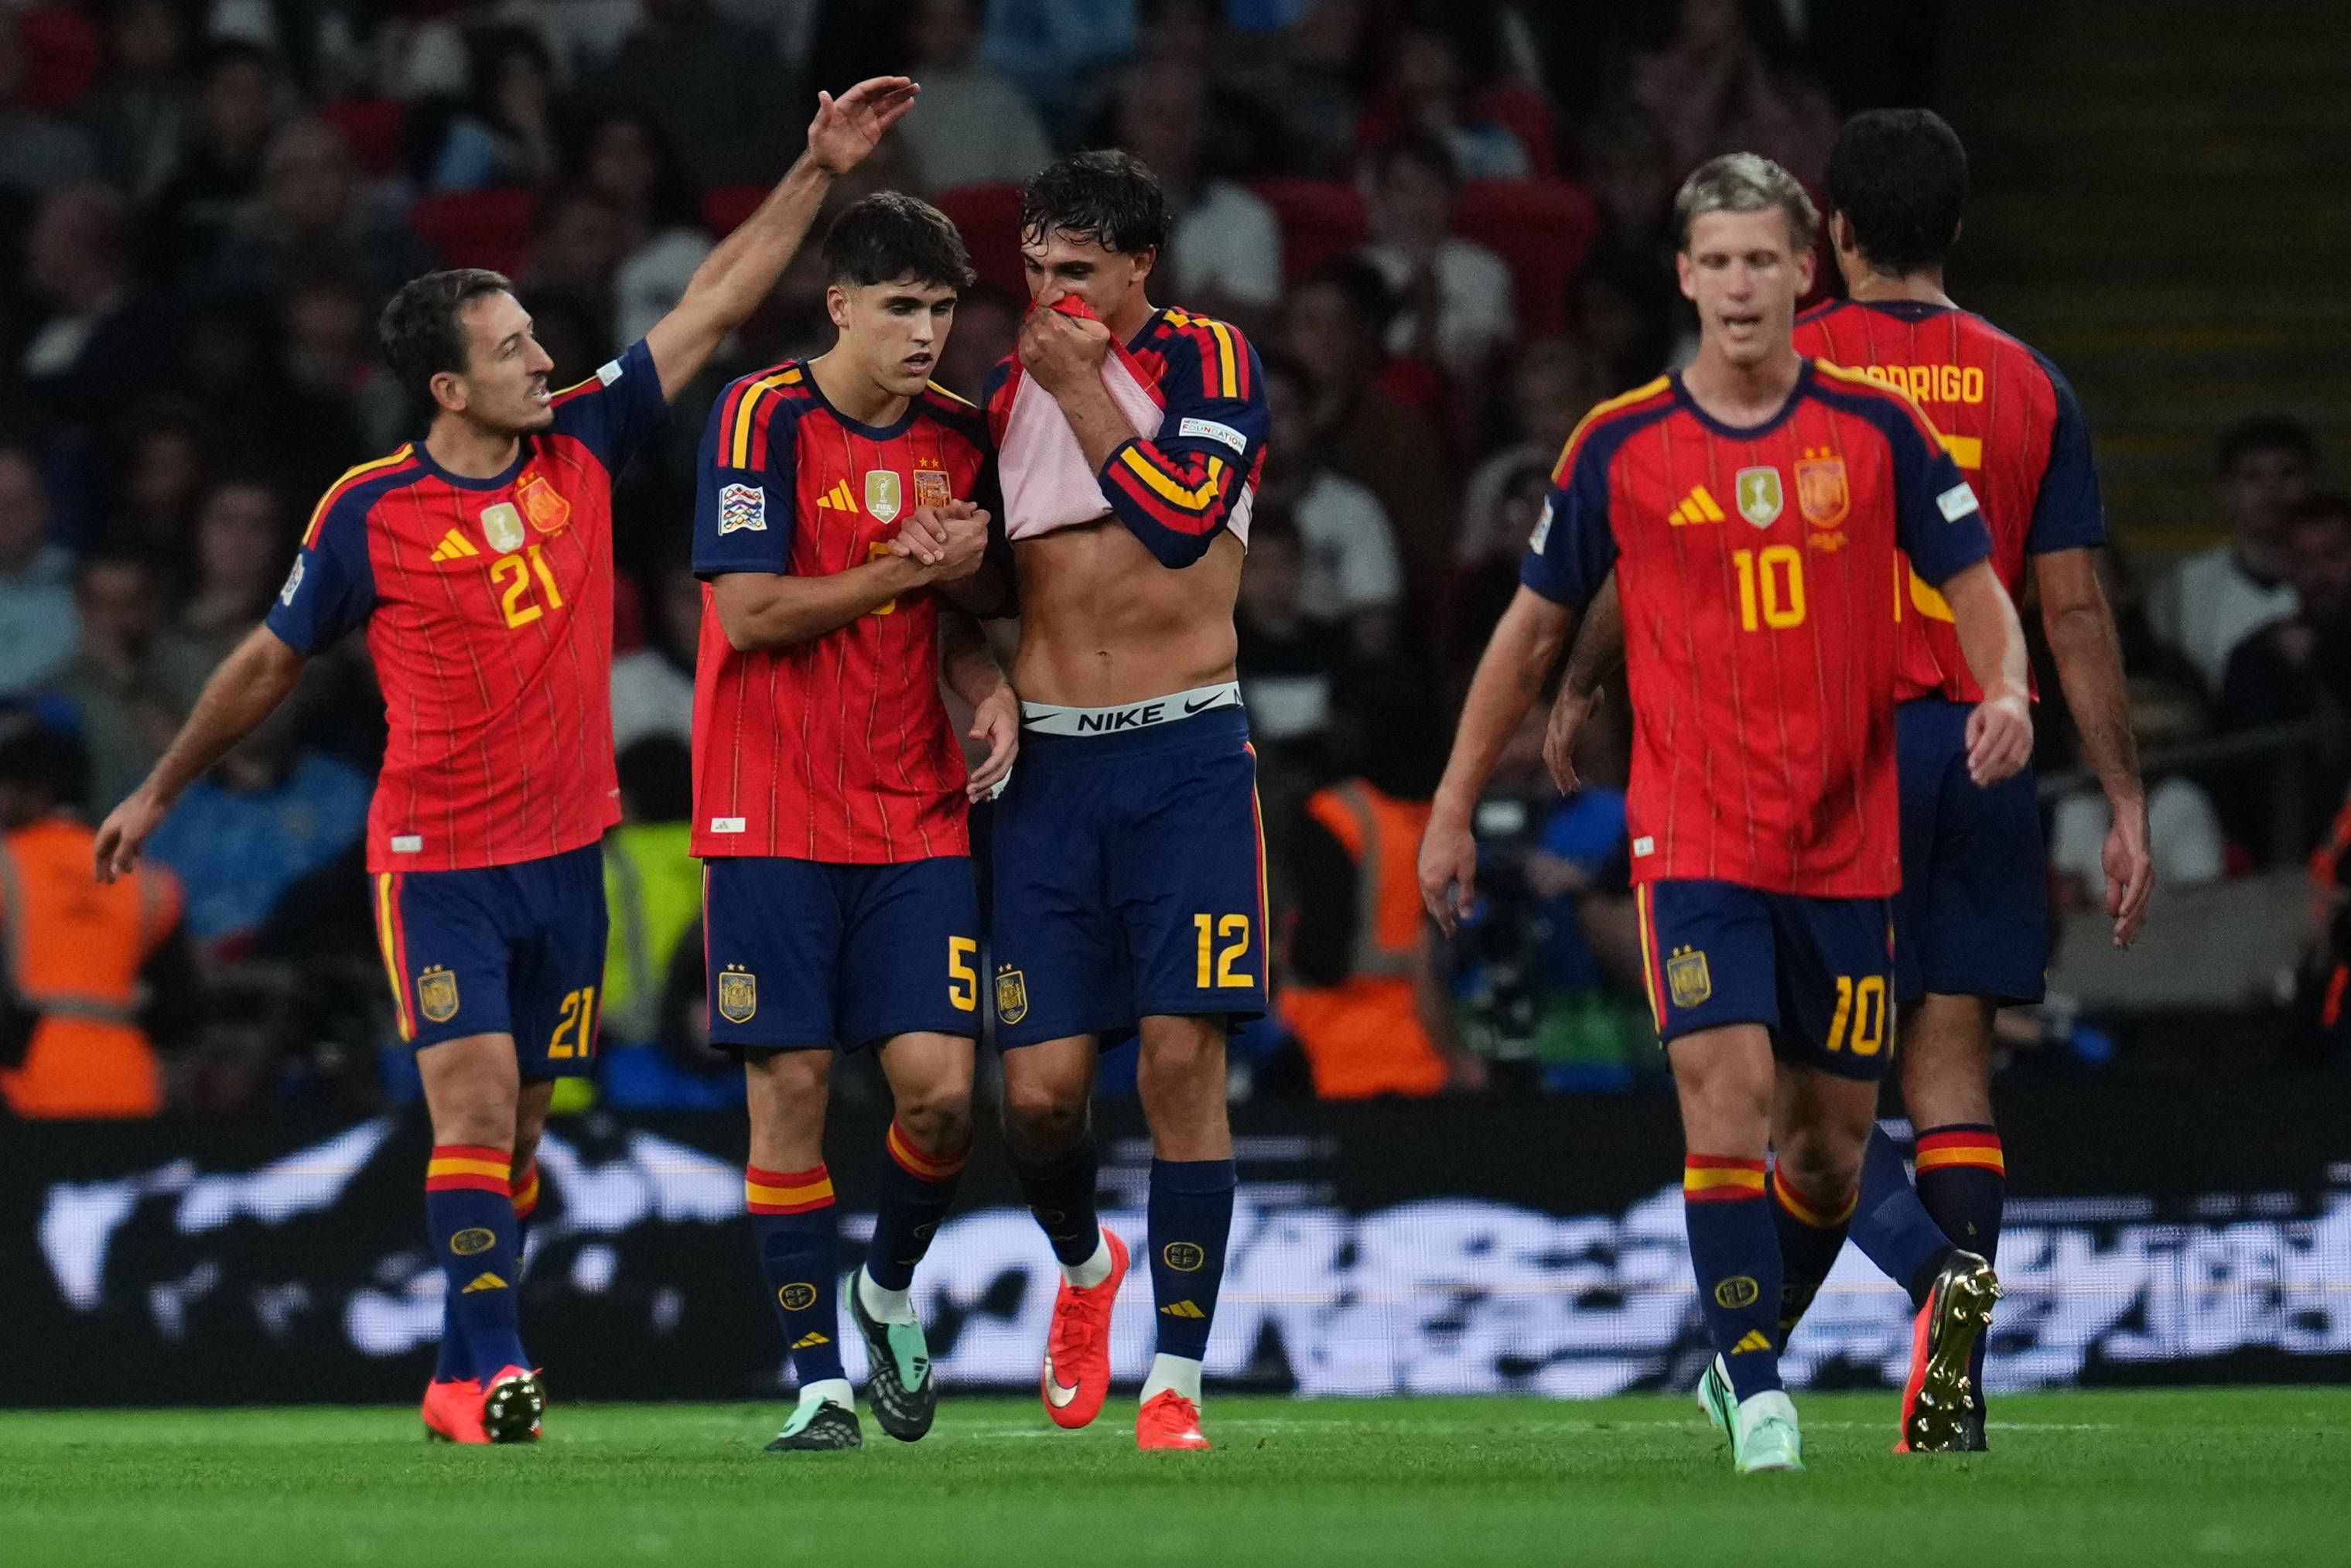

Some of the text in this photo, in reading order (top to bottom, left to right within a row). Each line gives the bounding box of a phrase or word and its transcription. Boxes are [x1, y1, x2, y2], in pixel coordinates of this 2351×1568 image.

[1182, 424, 1243, 449] FOUNDATION
[490, 544, 563, 629] 21
[1733, 545, 1806, 631] 10
[1078, 703, 1165, 731] NIKE
[948, 935, 976, 1012] 5
[1194, 914, 1253, 988] 12
[548, 986, 595, 1058] 21
[1826, 975, 1885, 1056] 10
